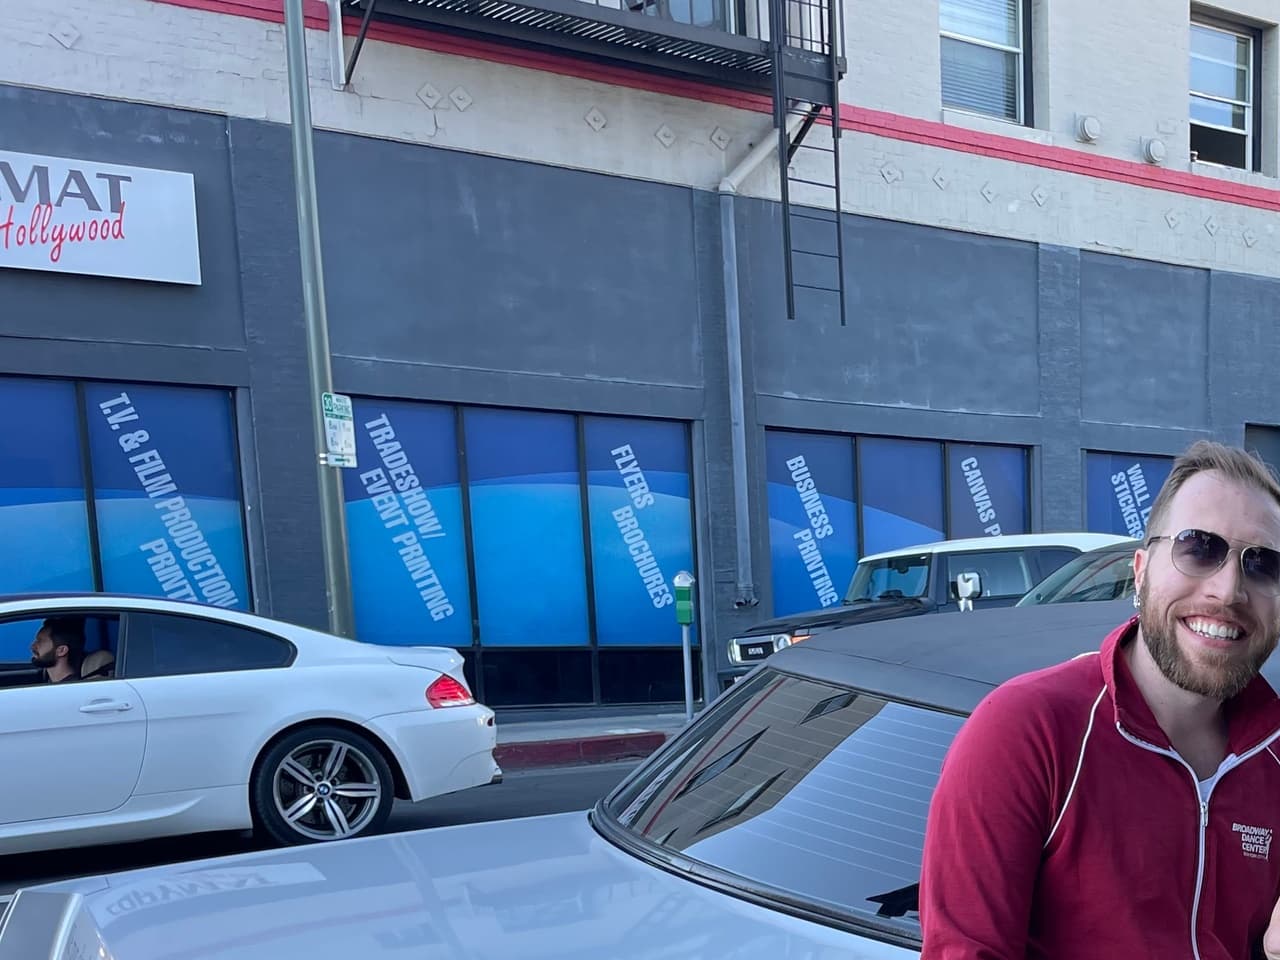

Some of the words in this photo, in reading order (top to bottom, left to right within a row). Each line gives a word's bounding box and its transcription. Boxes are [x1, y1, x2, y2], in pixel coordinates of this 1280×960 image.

[118, 429, 149, 453] &
[129, 449, 178, 498] FILM
[364, 413, 446, 539] TRADESHOW/
[611, 443, 654, 510] FLYERS
[786, 455, 833, 539] BUSINESS
[960, 456, 996, 523] CANVAS
[1111, 471, 1145, 539] STICKERS
[1127, 463, 1150, 506] WALL
[139, 538, 199, 600] PRINT
[155, 495, 239, 608] PRODUCTION
[360, 467, 409, 529] EVENT
[392, 531, 454, 622] PRINTING
[612, 505, 674, 609] BROCHURES
[793, 528, 839, 607] PRINTING
[1232, 823, 1269, 837] BROADWAY
[1241, 833, 1265, 845] DANCE
[1242, 843, 1268, 855] CENTER
